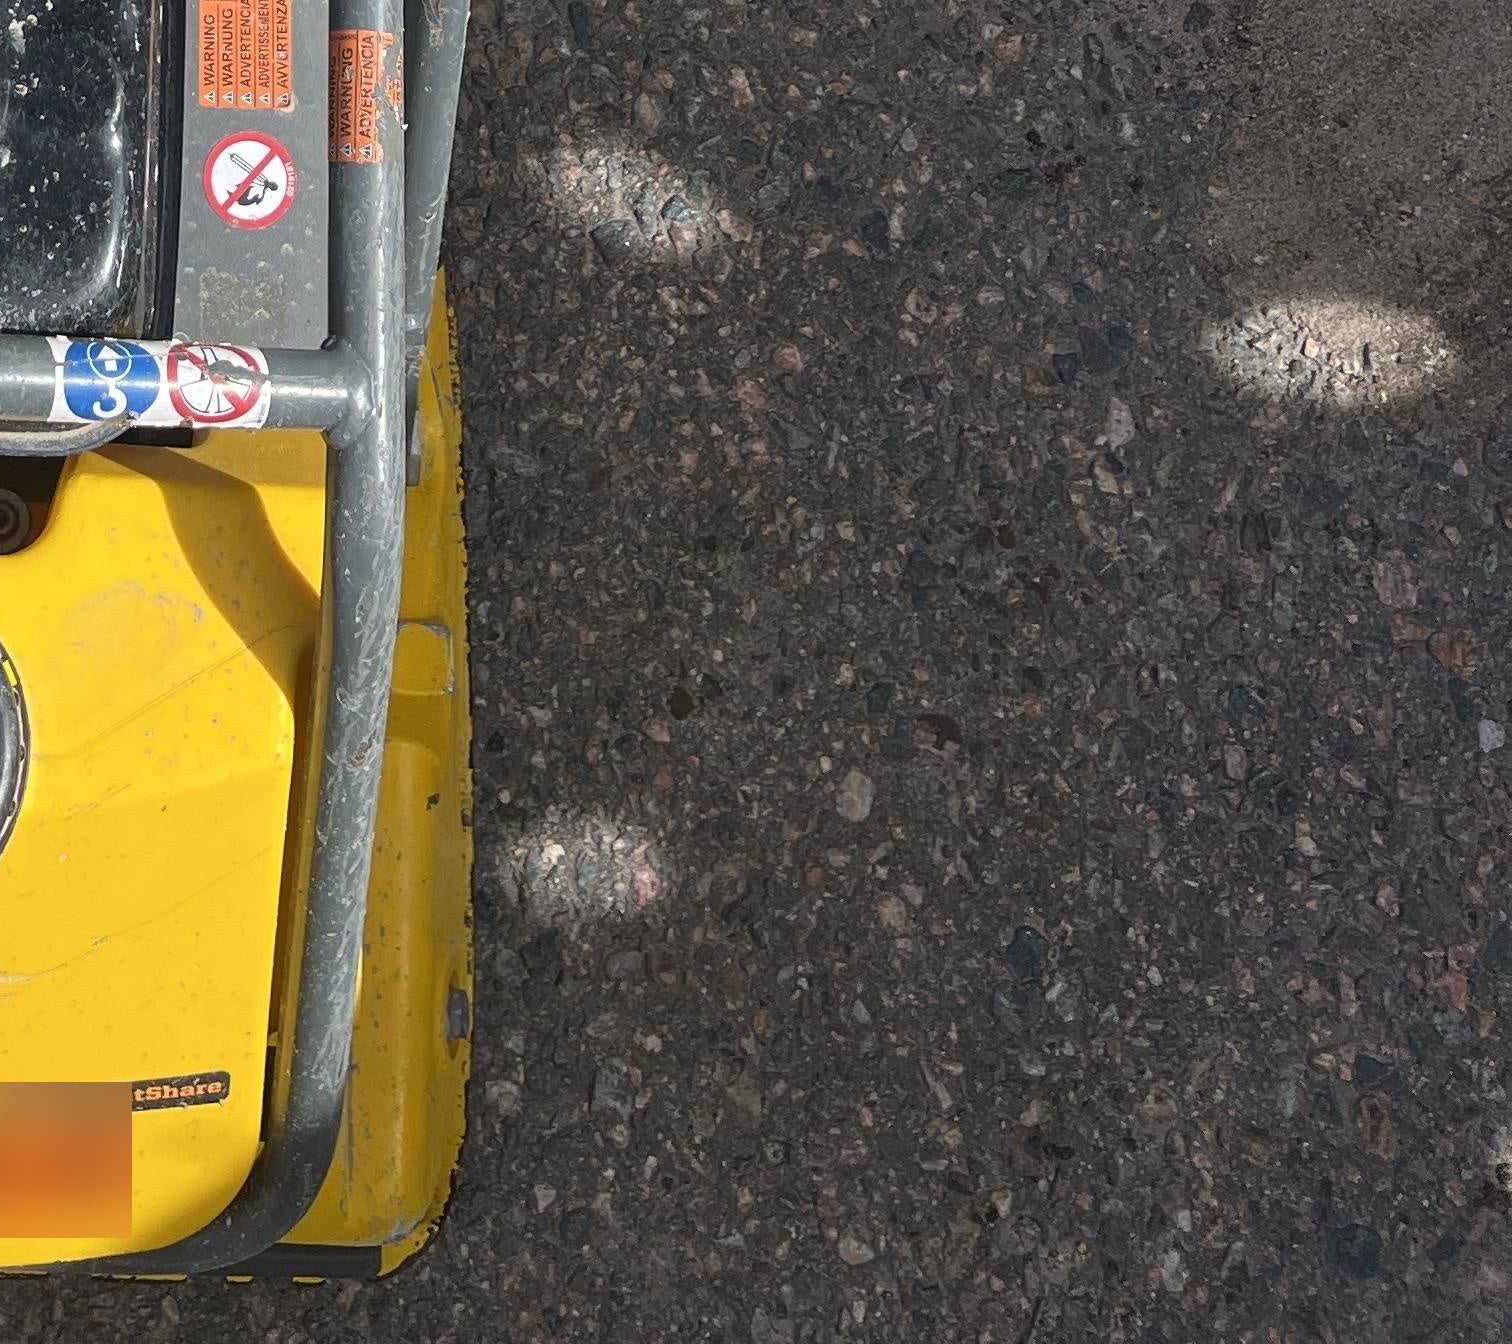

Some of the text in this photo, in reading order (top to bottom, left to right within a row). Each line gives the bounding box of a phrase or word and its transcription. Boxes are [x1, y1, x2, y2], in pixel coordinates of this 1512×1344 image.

[203, 14, 216, 86] WARNING
[221, 8, 234, 87] WARNUNG
[359, 34, 375, 139] ADVERTENCIA
